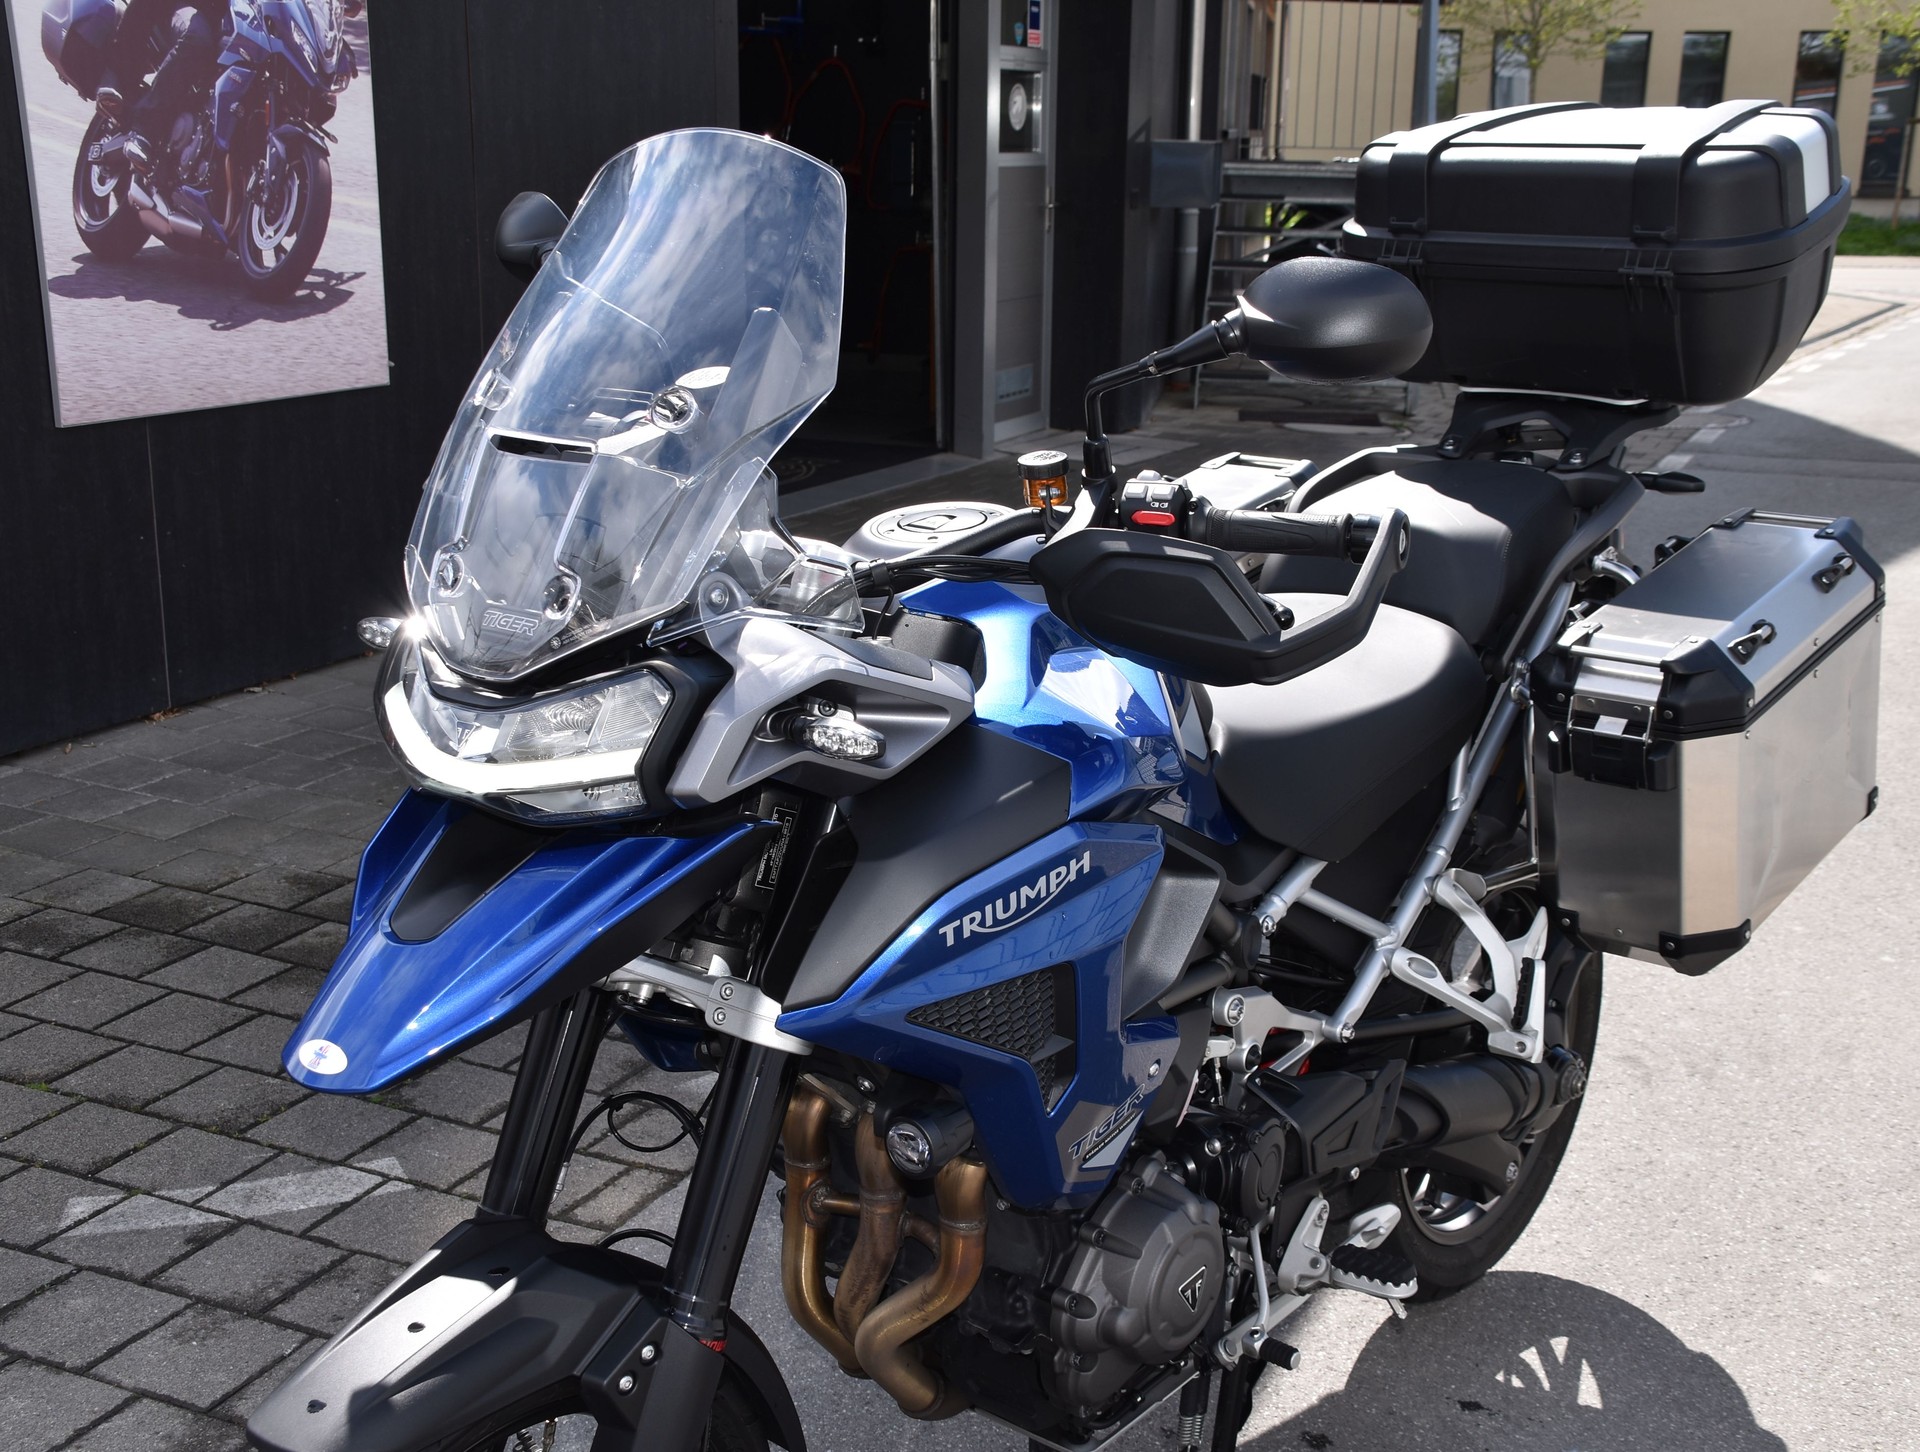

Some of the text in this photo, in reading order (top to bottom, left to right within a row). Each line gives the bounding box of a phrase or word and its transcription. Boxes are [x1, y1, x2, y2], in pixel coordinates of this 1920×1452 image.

[482, 609, 540, 636] TIGER
[938, 850, 1091, 947] TRIUMPH
[1068, 1083, 1146, 1160] TIGER
